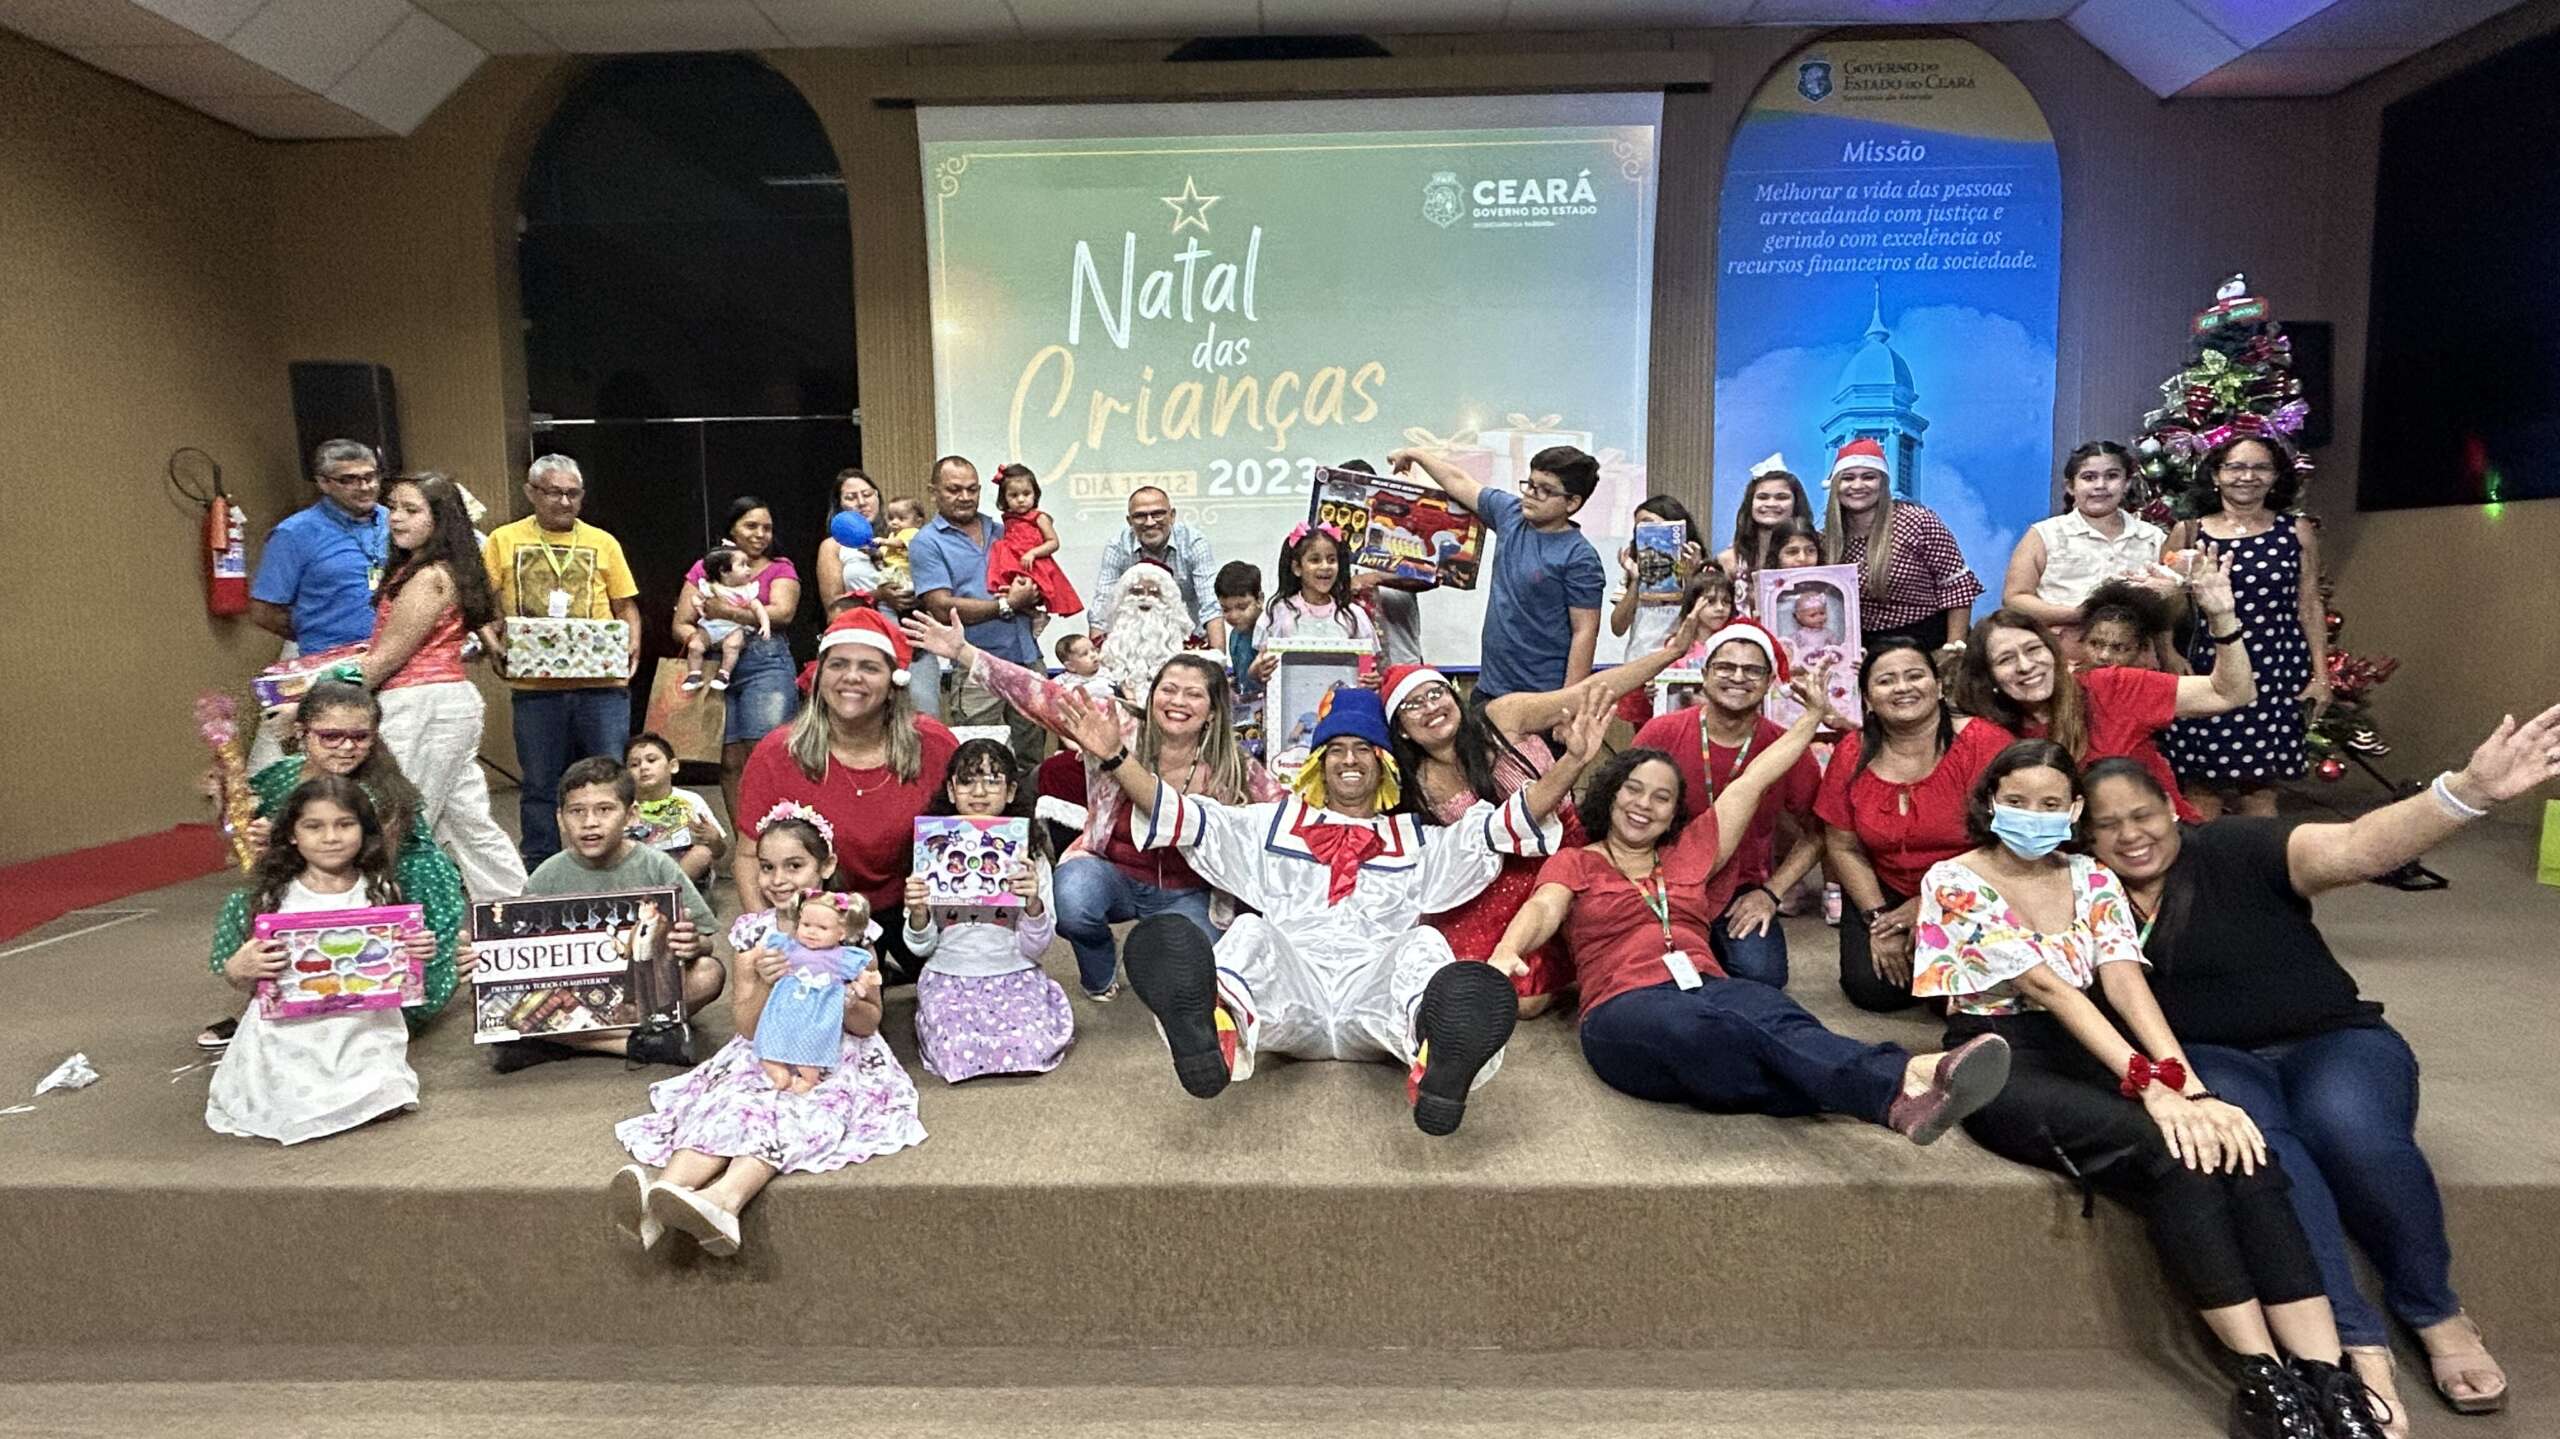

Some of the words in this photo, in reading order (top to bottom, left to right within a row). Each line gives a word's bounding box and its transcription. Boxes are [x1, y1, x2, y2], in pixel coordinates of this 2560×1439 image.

[1843, 62, 1917, 74] GOVERNO
[1921, 63, 1939, 73] DO
[1843, 76, 1901, 90] ESTADO
[1906, 79, 1922, 89] DO
[1843, 140, 1925, 162] Missão
[1473, 168, 1597, 205] CEARÁ
[1755, 182, 1843, 202] Melhorar
[1846, 186, 1858, 199] a
[1863, 180, 1902, 199] vida
[1908, 179, 1940, 198] das
[1941, 182, 2013, 202] pessoas
[1473, 207, 1530, 217] GOVERNO
[1532, 206, 1549, 216] DO
[1552, 205, 1597, 215] ESTADO
[1760, 205, 1880, 225] arrecadando
[1884, 208, 1922, 223] com
[1922, 203, 1988, 226] justiça
[1994, 206, 2004, 220] e
[1763, 230, 1835, 254] gerindo
[1839, 233, 1878, 248] com
[1882, 227, 1979, 247] excelência
[1983, 231, 2003, 245] os
[1727, 259, 1804, 275] recursos
[1804, 252, 1911, 277] financeiros
[1915, 253, 1938, 270] da
[1943, 250, 2037, 270] sociedade.
[1069, 225, 1262, 349] Natal
[1192, 322, 1250, 373] das
[1009, 345, 1386, 485] Crianças
[1074, 475, 1117, 496] DIA
[1208, 457, 1319, 496] 2023
[478, 939, 619, 973] SUSPEITO
